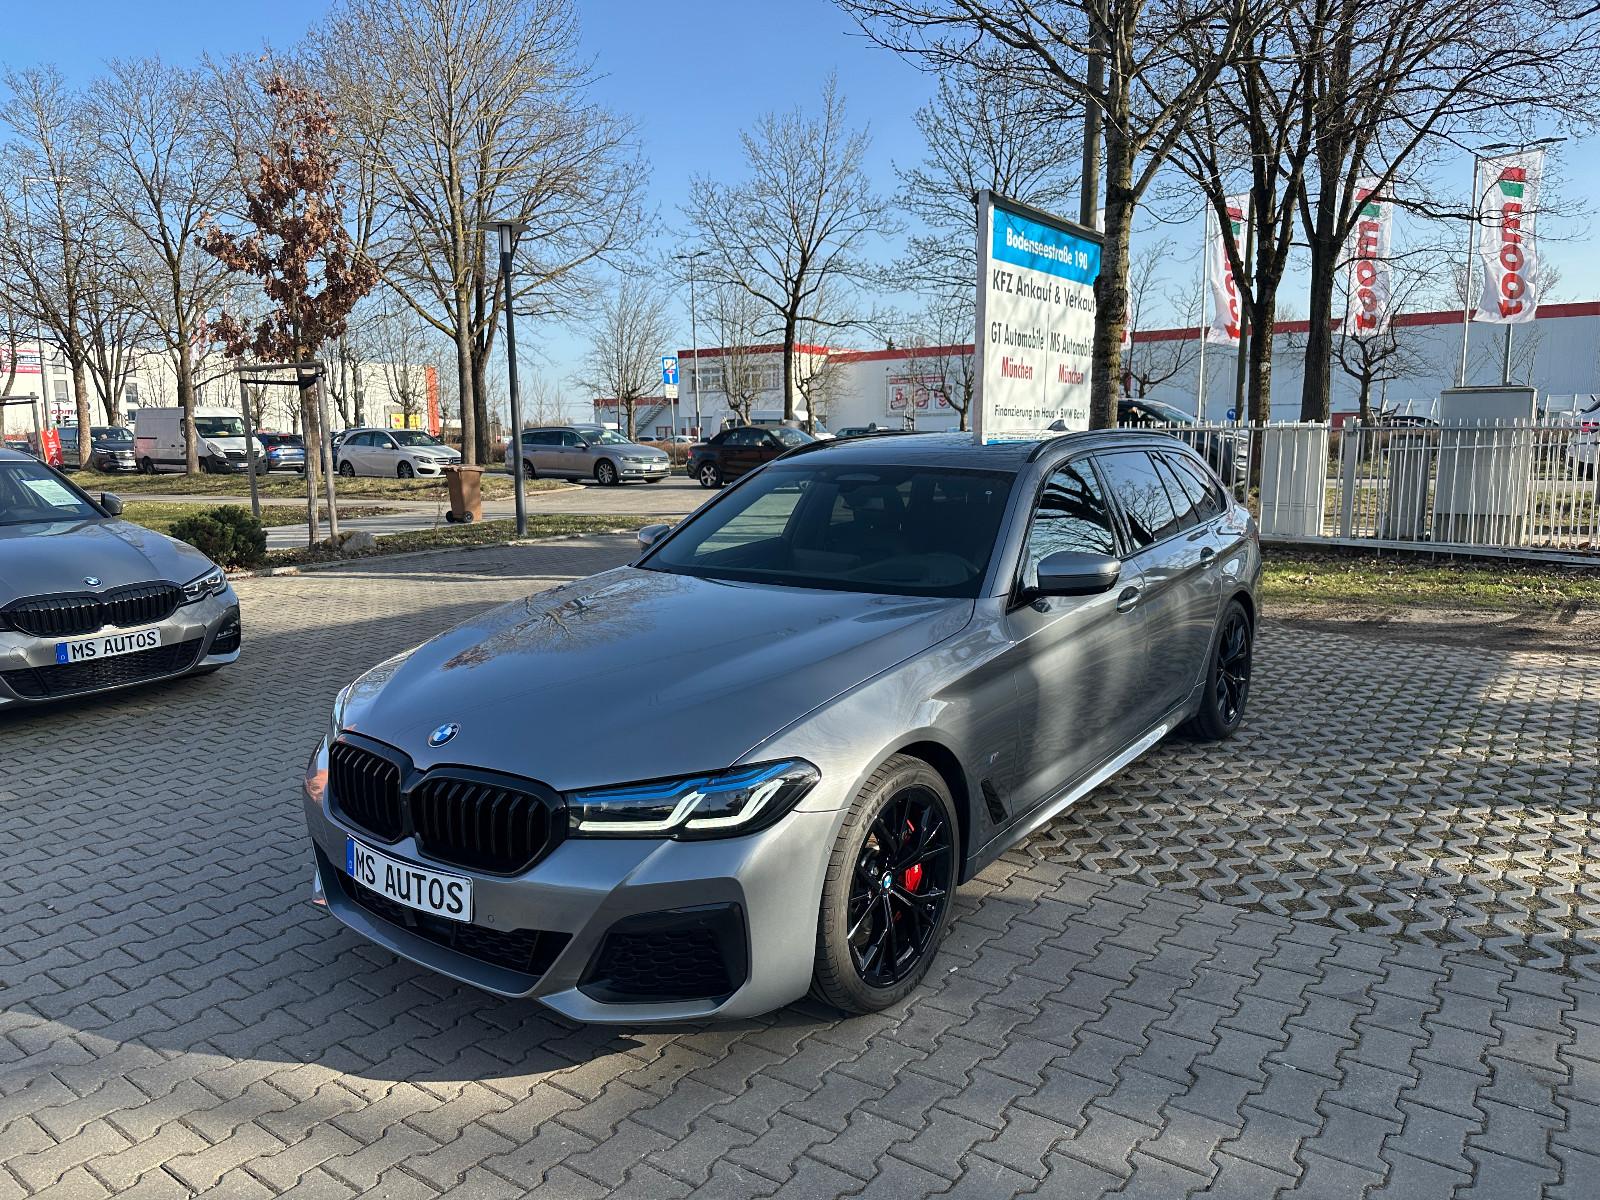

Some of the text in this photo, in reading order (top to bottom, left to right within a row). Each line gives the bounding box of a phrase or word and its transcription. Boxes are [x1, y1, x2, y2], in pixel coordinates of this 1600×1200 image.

[1006, 228, 1088, 270] Bodenseestraße 190
[1498, 202, 1525, 319] toom
[993, 269, 1013, 293] KFZ
[1016, 275, 1052, 303] Ankauf
[1054, 285, 1061, 305] &
[1356, 220, 1380, 330] toom
[991, 321, 1044, 351] GT Automobile
[1050, 332, 1061, 353] MS
[1002, 356, 1033, 380] München
[1058, 363, 1084, 385] München
[995, 404, 1032, 420] Finanzierung
[1033, 406, 1041, 417] im
[1042, 407, 1055, 418] Haus
[71, 641, 96, 659] MS
[104, 631, 157, 655] AUTOS
[355, 847, 376, 885] MS
[385, 863, 463, 914] AUTOS
